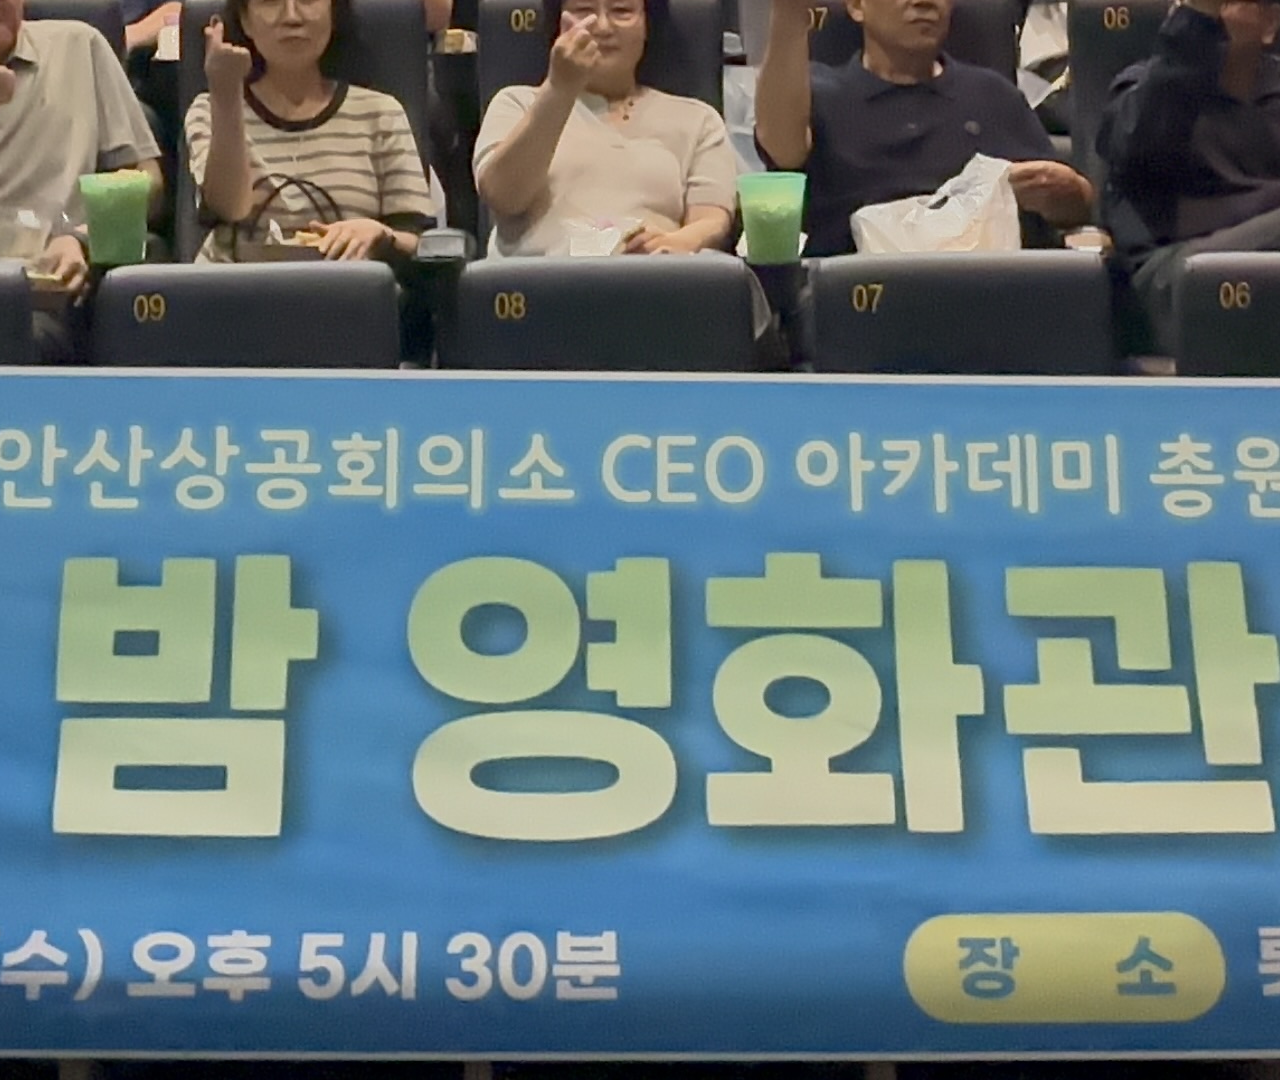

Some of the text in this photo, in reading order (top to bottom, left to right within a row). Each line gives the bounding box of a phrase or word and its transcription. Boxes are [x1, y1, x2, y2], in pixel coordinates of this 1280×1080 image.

[1103, 5, 1130, 29] 06
[133, 294, 167, 323] 09
[494, 291, 526, 319] 08
[852, 283, 884, 315] 07
[1219, 280, 1251, 310] 06
[600, 432, 767, 506] CEO
[793, 430, 1123, 516] 아카데미
[52, 552, 319, 839] 밤
[126, 929, 273, 1001] 오후
[297, 930, 419, 1000] 5시
[445, 929, 621, 1000] 30분
[957, 936, 1177, 1001] 장 소
